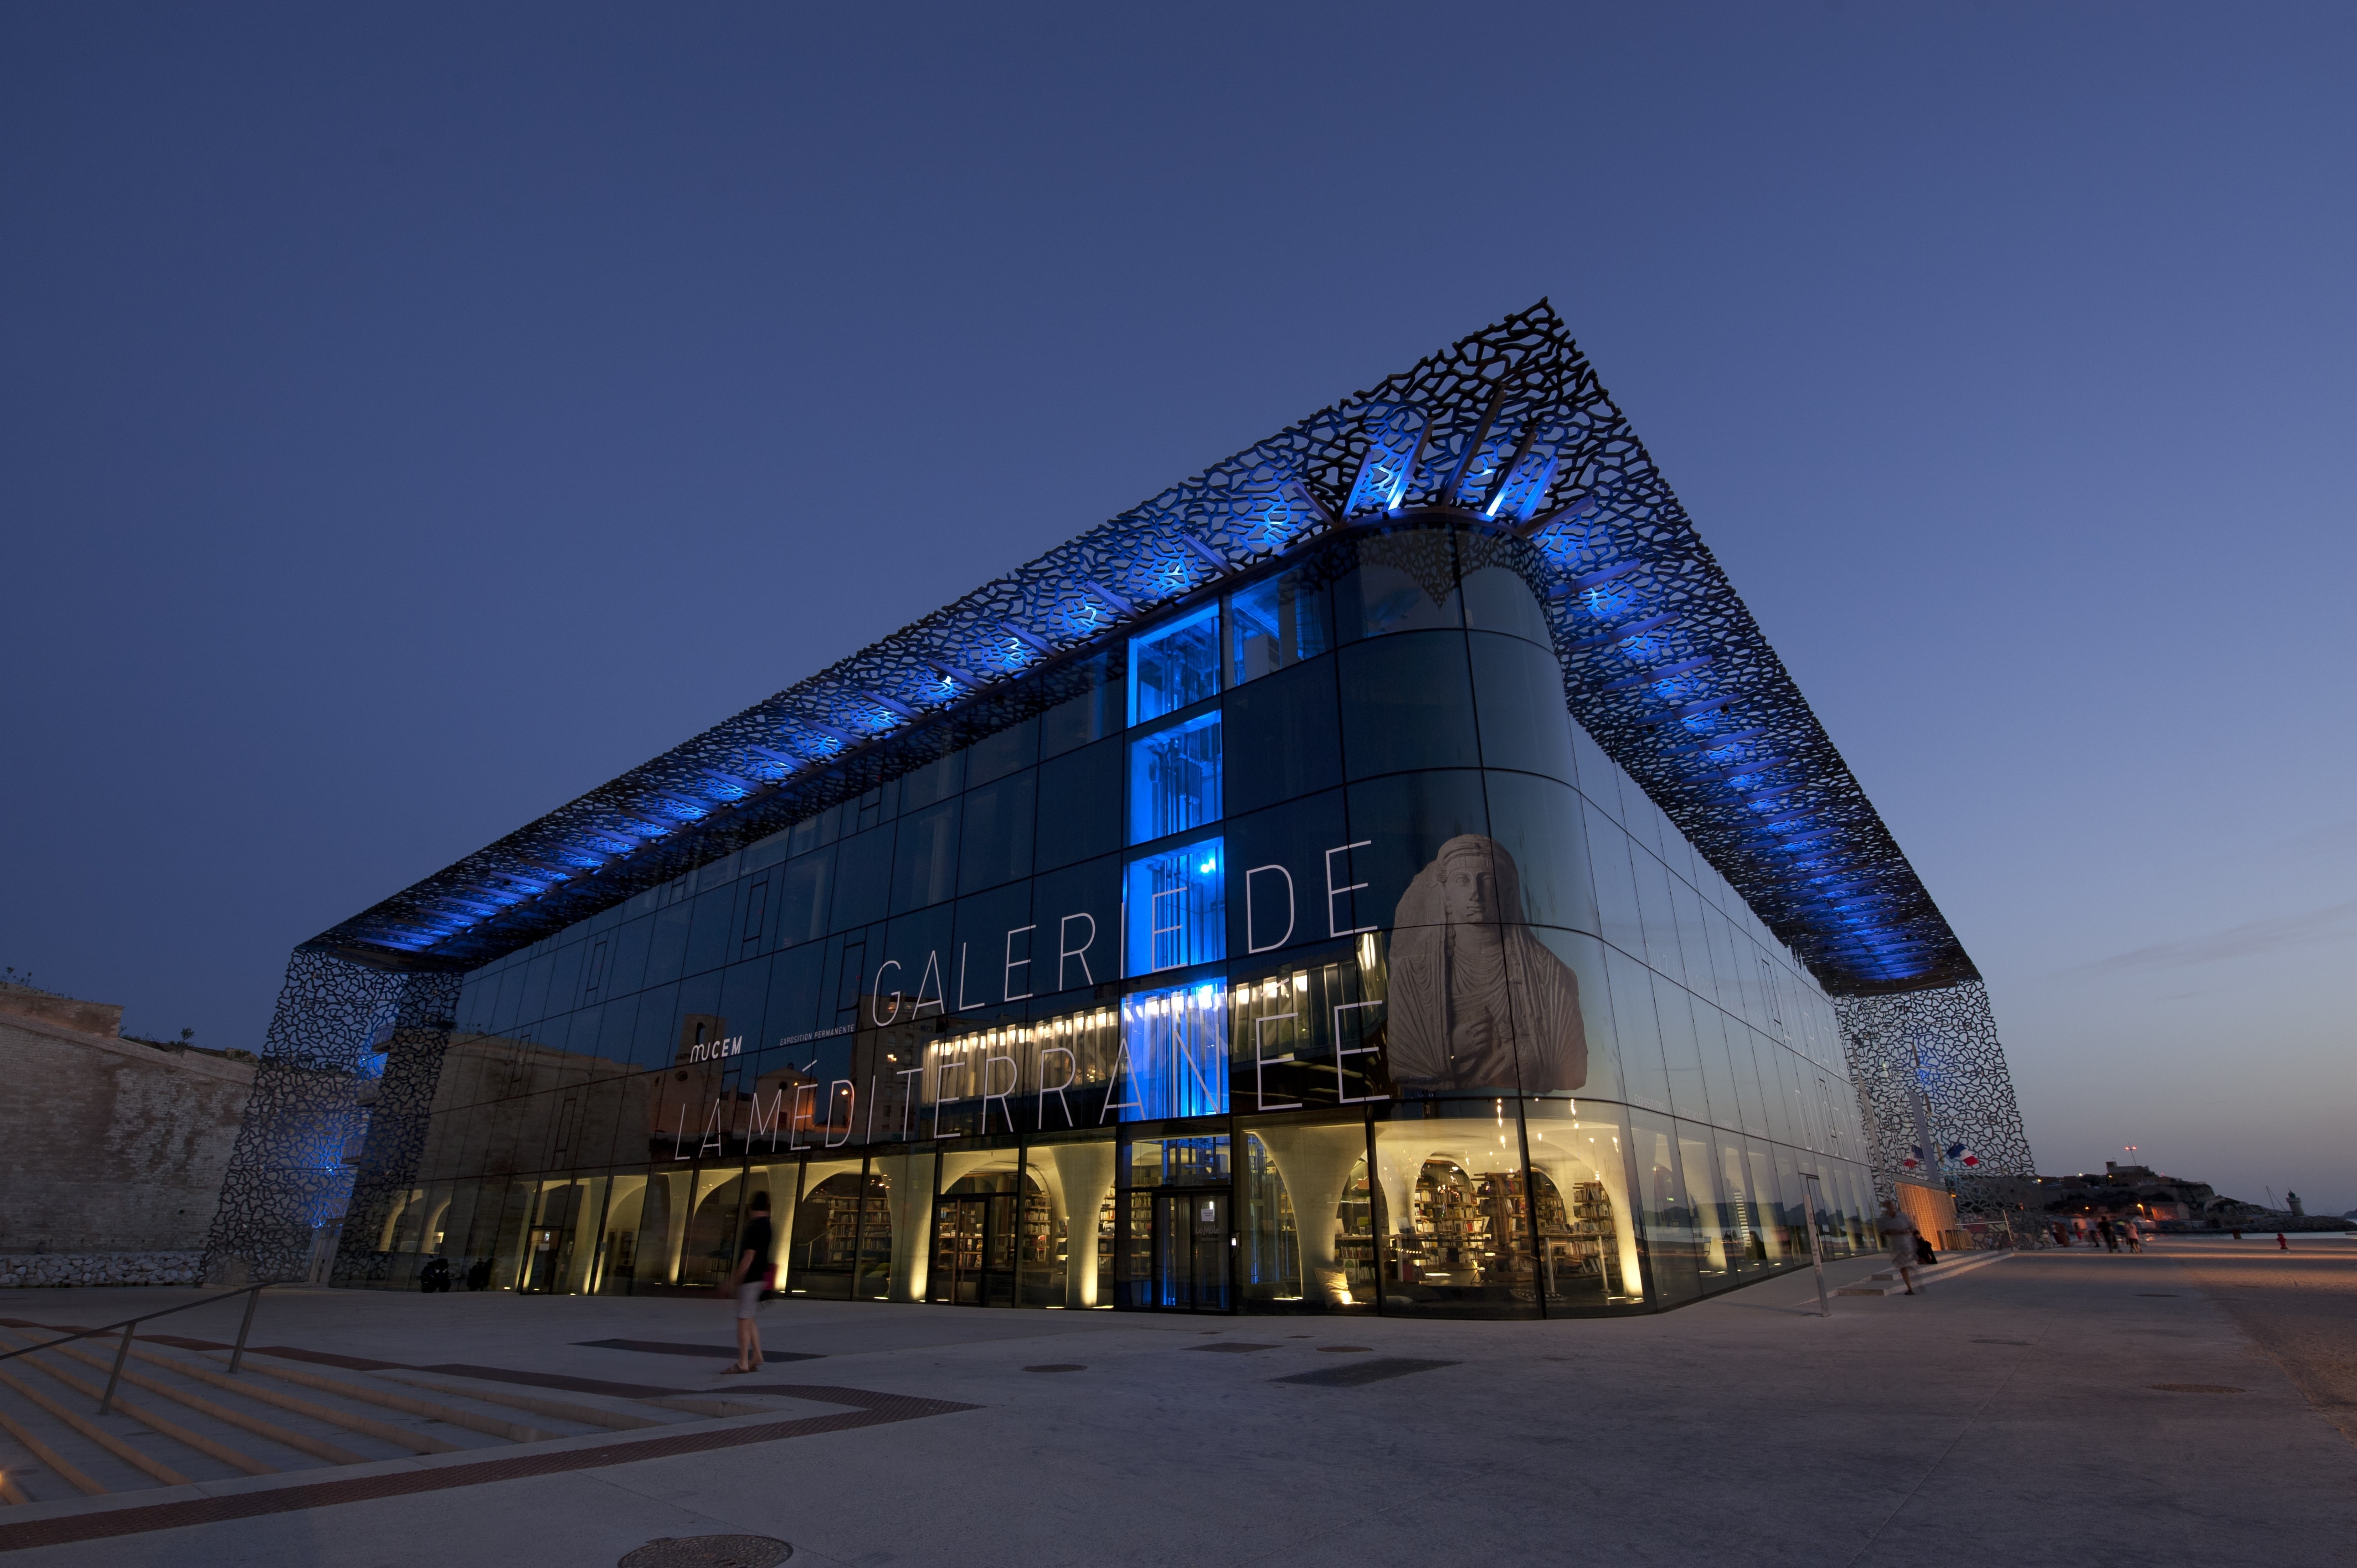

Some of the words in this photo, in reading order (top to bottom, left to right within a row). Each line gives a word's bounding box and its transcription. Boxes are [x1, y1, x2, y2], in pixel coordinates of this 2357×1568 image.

[872, 886, 1188, 1027] GALERIE
[1246, 840, 1378, 954] DE
[780, 1032, 813, 1046] EXPOSITION
[814, 1024, 855, 1039] PERMANENTE
[675, 1098, 722, 1160] LA
[745, 978, 1391, 1155] MÉDITERRANÉE
[1634, 1094, 1666, 1113] EXPOSITIONS
[1794, 1089, 1824, 1154] DU
